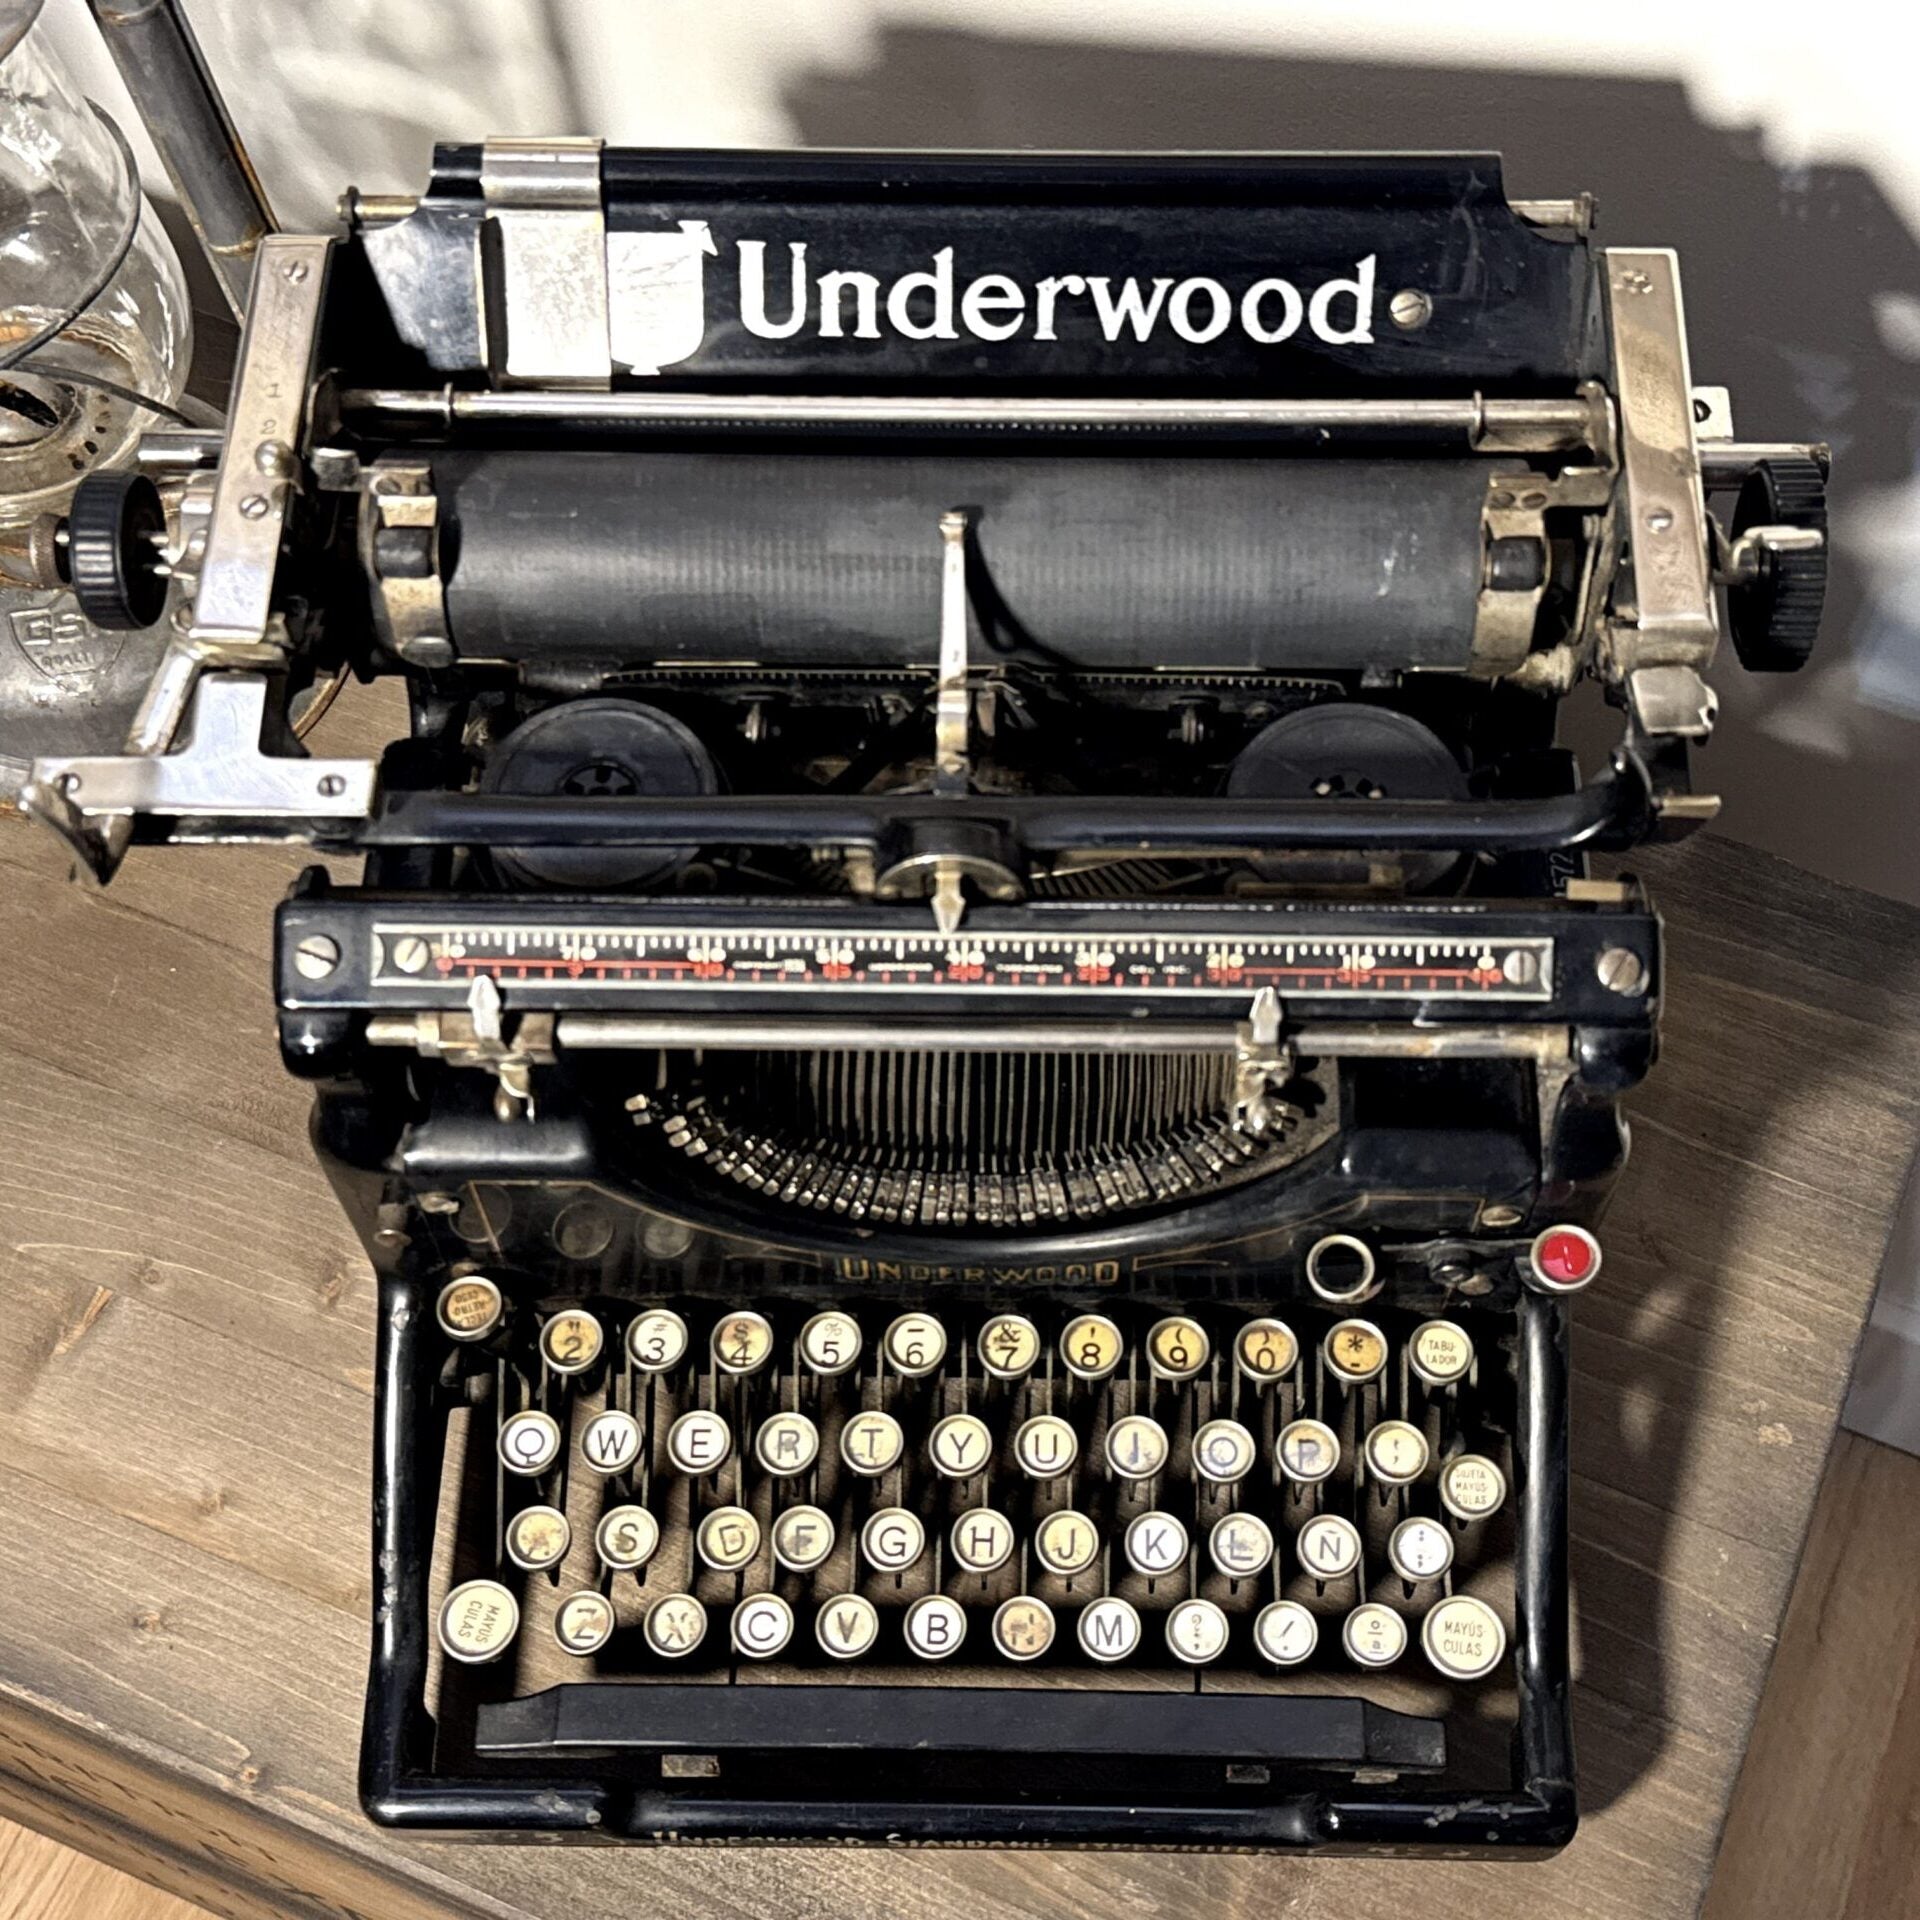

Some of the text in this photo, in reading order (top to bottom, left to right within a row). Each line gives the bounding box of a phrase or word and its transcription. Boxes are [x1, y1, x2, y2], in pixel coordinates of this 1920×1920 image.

[736, 240, 1376, 345] Underwood
[260, 419, 277, 435] 2
[841, 1257, 1119, 1284] UNDERWOOD
[999, 1320, 1021, 1344] &
[562, 1336, 583, 1361] 2
[645, 1337, 666, 1362] 3
[731, 1340, 752, 1365] 4
[821, 1341, 840, 1366] 5
[906, 1342, 924, 1367] 6
[995, 1346, 1018, 1369] 7
[1080, 1343, 1100, 1367] 8
[1169, 1346, 1188, 1369] 9
[1256, 1347, 1275, 1371] 0
[514, 1427, 545, 1464] Q
[597, 1429, 628, 1460] W
[690, 1429, 712, 1459] E
[777, 1430, 800, 1460] R
[861, 1428, 883, 1458] T
[948, 1432, 973, 1464] Y
[1034, 1434, 1058, 1464] U
[1209, 1436, 1238, 1467] O
[1298, 1438, 1321, 1470] P
[617, 1522, 639, 1553] S
[719, 1524, 746, 1557] D
[795, 1525, 817, 1555] F
[879, 1526, 907, 1557] G
[970, 1526, 995, 1559] H
[1054, 1527, 1076, 1560] J
[1145, 1528, 1168, 1560] K
[1229, 1529, 1254, 1562] L
[1319, 1529, 1341, 1562] Ñ
[457, 1600, 483, 1638] CULAS
[573, 1608, 598, 1640] Z
[662, 1612, 689, 1646] X
[749, 1611, 778, 1641] C
[837, 1611, 859, 1643] V
[926, 1613, 949, 1645] B
[1095, 1615, 1123, 1646] M
[1443, 1640, 1483, 1657] CULAS
